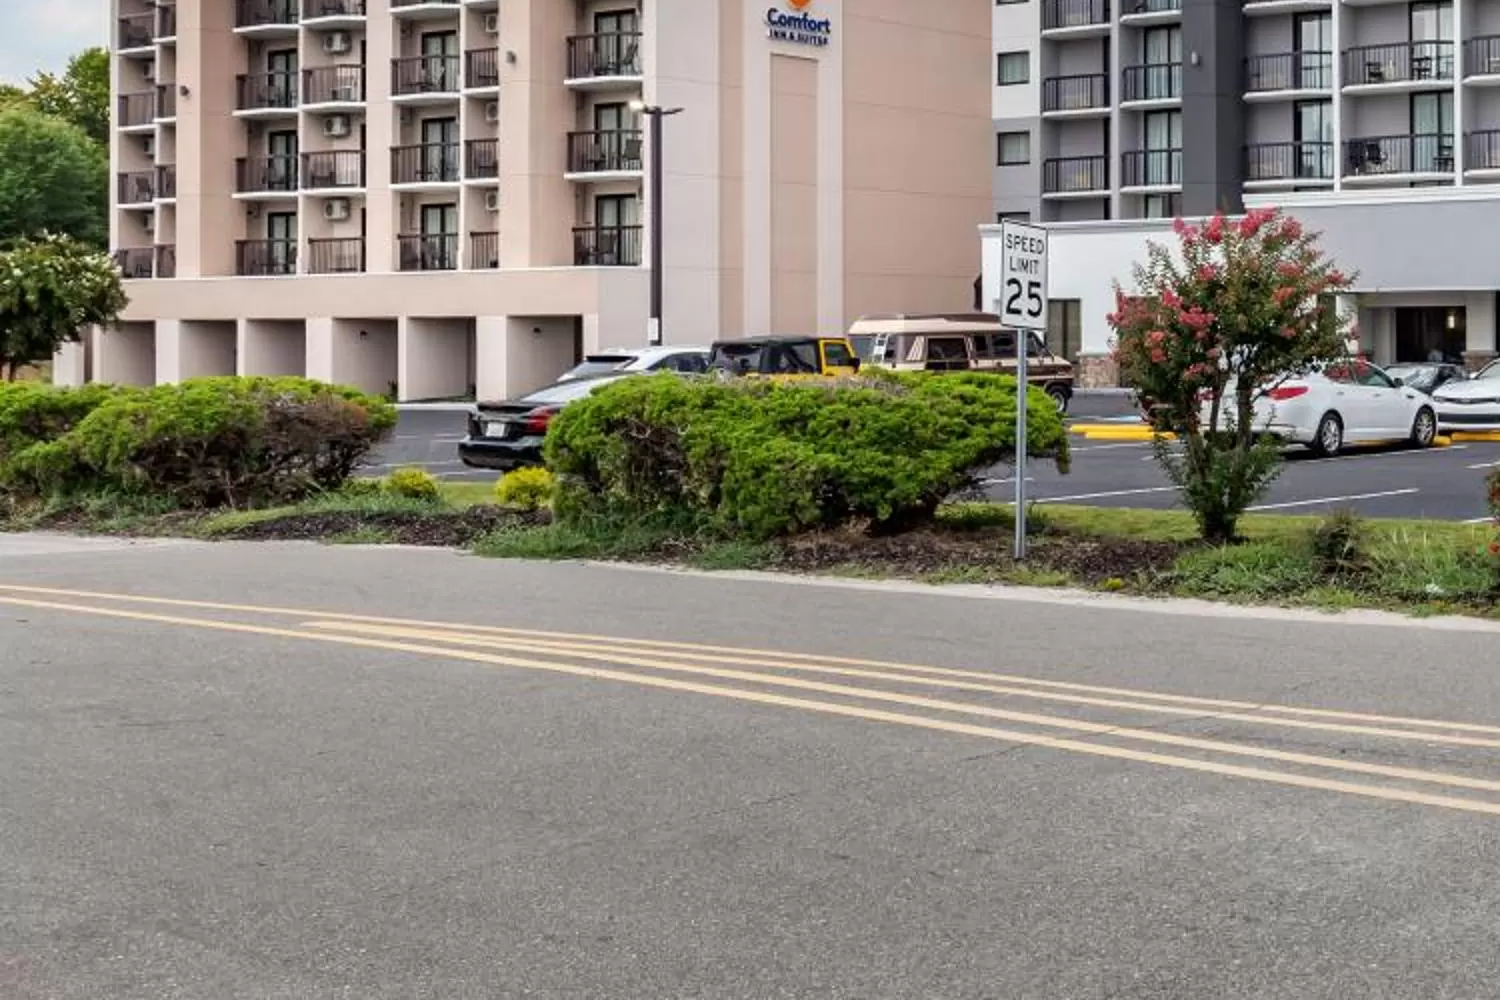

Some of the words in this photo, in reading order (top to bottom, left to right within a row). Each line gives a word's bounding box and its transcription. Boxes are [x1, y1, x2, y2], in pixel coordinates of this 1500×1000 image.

[766, 7, 831, 34] Comfort
[1006, 233, 1045, 255] SPEED
[1009, 256, 1040, 275] LIMIT
[1006, 277, 1043, 318] 25
